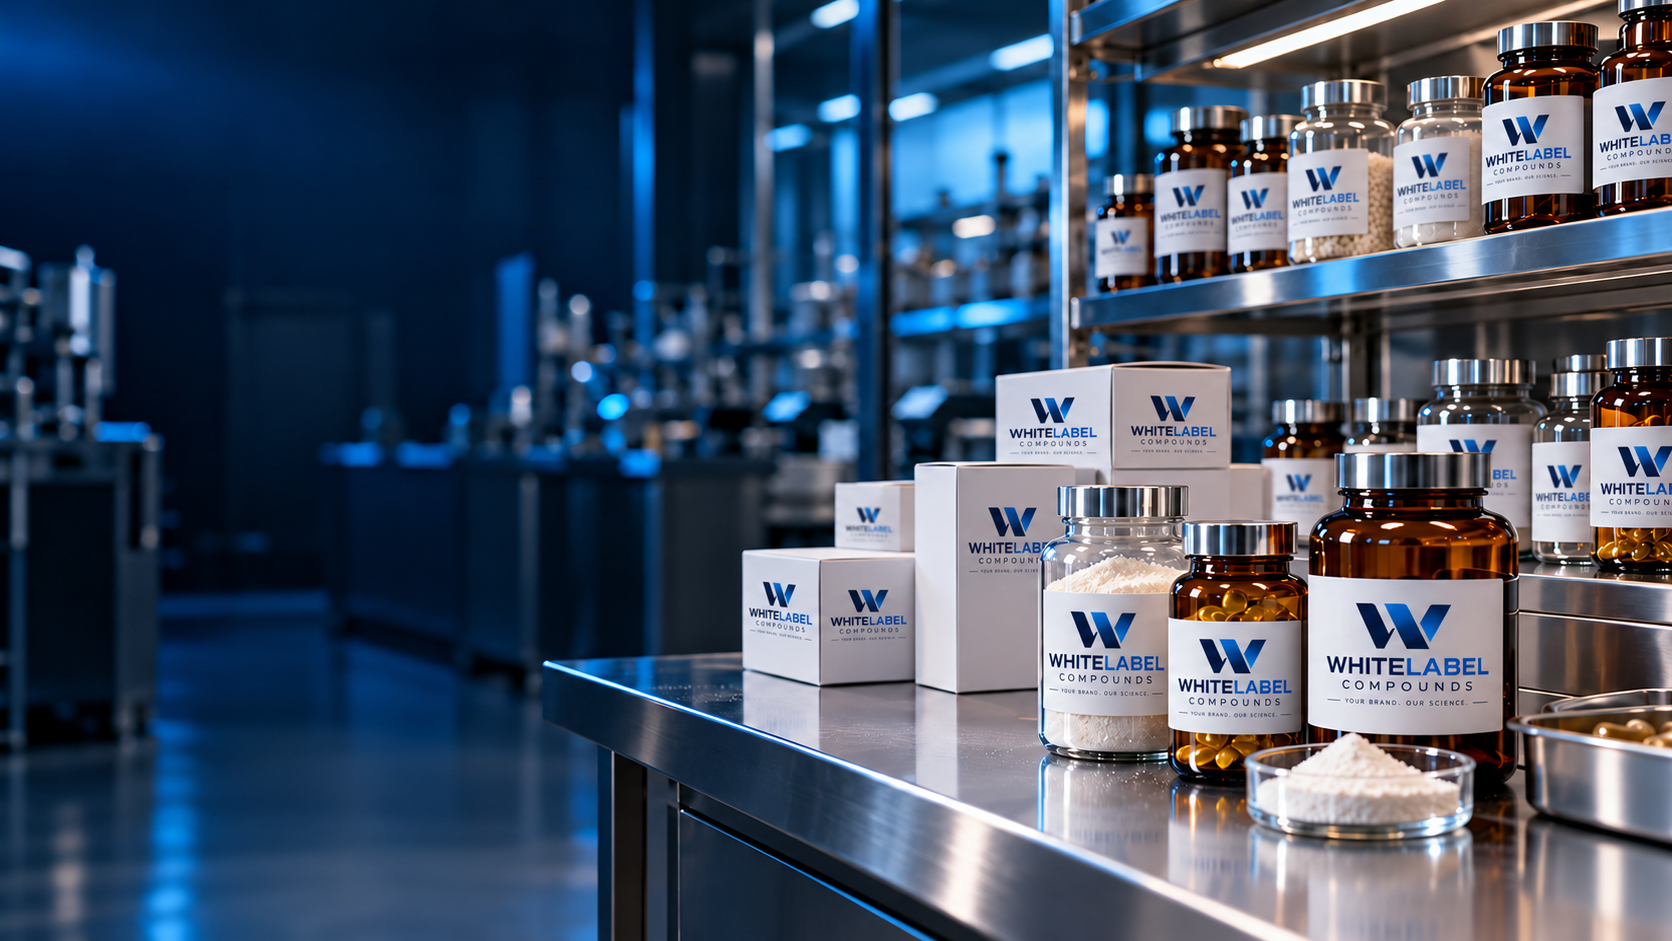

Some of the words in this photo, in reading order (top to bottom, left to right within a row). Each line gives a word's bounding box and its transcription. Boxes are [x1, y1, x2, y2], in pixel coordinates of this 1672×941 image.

[1615, 101, 1667, 133] W
[1502, 115, 1550, 147] W
[1411, 153, 1448, 179] W
[1486, 147, 1572, 168] WHITELABEL
[1494, 162, 1561, 176] COMPOUNDS
[1306, 166, 1342, 192] W
[1173, 185, 1205, 208] W
[1397, 180, 1467, 197] WHITELABEL
[1241, 188, 1269, 210] W
[1292, 193, 1360, 209] WHITELABEL
[1404, 193, 1459, 205] COMPOUNDS
[1160, 209, 1221, 223] WHITELABEL
[1232, 211, 1284, 225] WHITELABEL
[1298, 206, 1352, 217] COMPOUNDS
[1031, 397, 1075, 424] W
[1150, 396, 1196, 422] W
[1010, 427, 1097, 439] WHITELABEL
[1131, 426, 1216, 437] WHITELABEL
[1618, 446, 1672, 477] W
[1547, 465, 1582, 489] W
[1536, 492, 1590, 502] WHITELABE
[857, 507, 881, 523] W
[989, 507, 1037, 537] W
[969, 542, 1046, 554] WHITELAB
[763, 582, 796, 608] W
[848, 590, 889, 613] W
[749, 608, 813, 625] WHITELABEL
[831, 616, 907, 627] WHITELABEL
[756, 620, 805, 633] COMPOUNDS
[840, 627, 899, 635] COMPOUNDS
[1071, 611, 1136, 649] W
[1356, 603, 1451, 649] W
[1049, 653, 1164, 671] WHITELABEL
[1199, 639, 1266, 673] W
[1327, 656, 1489, 676] WHITELABEL
[1059, 673, 1152, 684] COMPOUNDS
[1178, 678, 1292, 694] WHITELABEL
[1342, 680, 1472, 692] COMPOUNDS
[1189, 697, 1281, 706] COMPOUNDS
